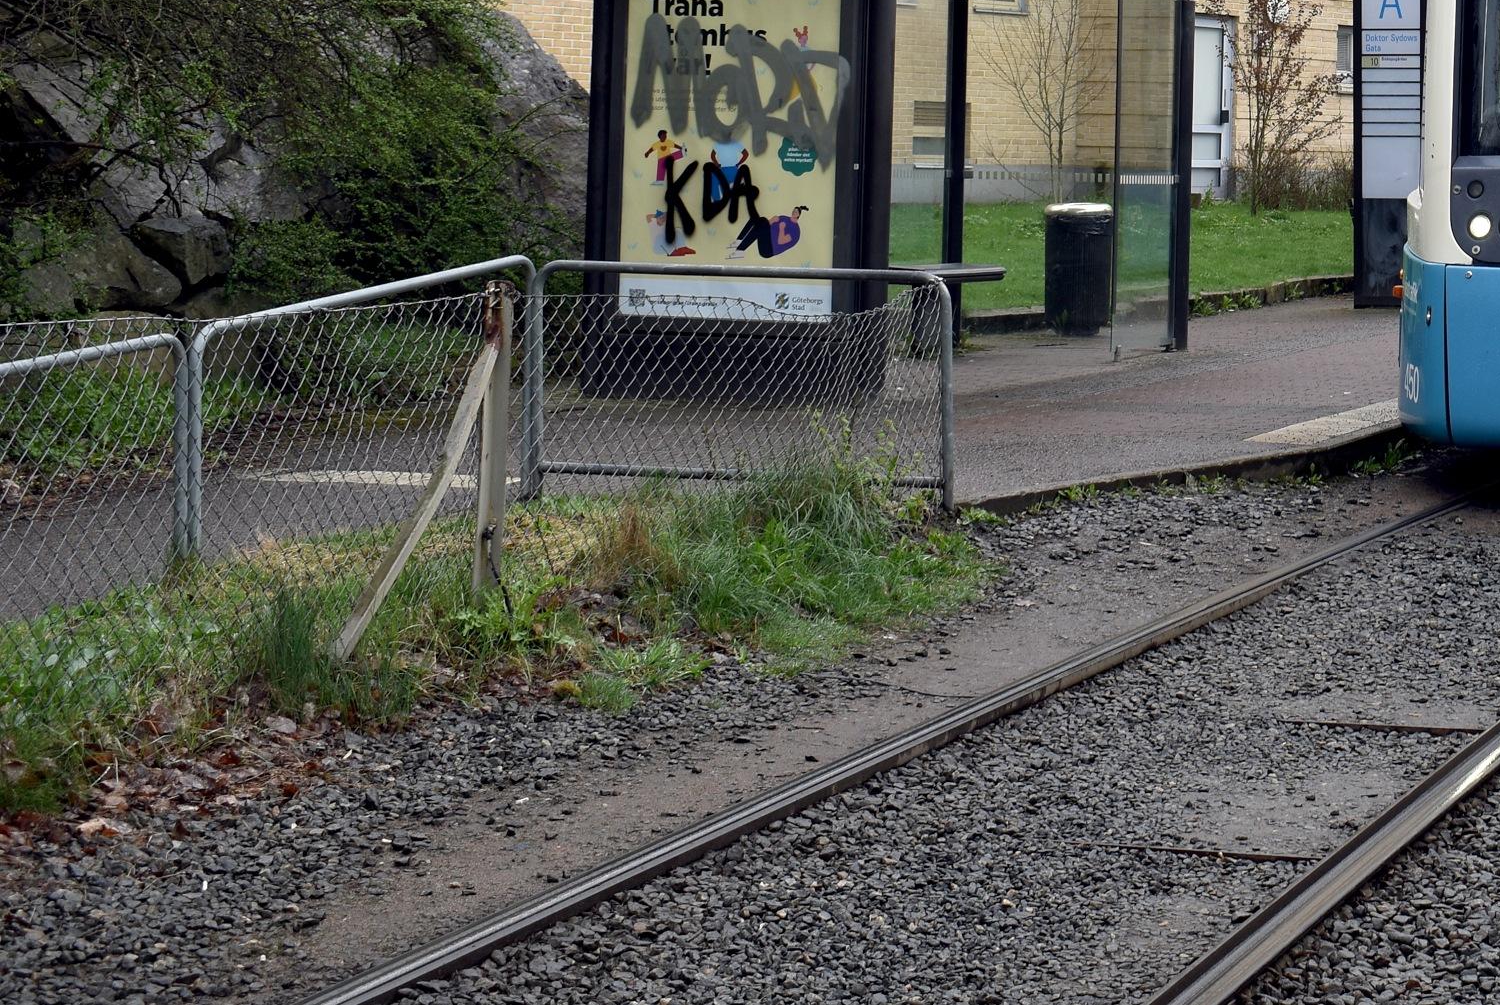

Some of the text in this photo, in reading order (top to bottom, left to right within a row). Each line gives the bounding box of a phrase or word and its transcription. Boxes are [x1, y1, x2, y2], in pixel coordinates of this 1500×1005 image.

[650, 24, 768, 48] tomhs
[1365, 33, 1418, 44] Doktor Sydows
[1365, 44, 1382, 53] Gata
[1370, 57, 1379, 67] 10
[791, 296, 824, 307] Göteborgs
[791, 304, 806, 312] Stad
[1404, 363, 1420, 404] 450
